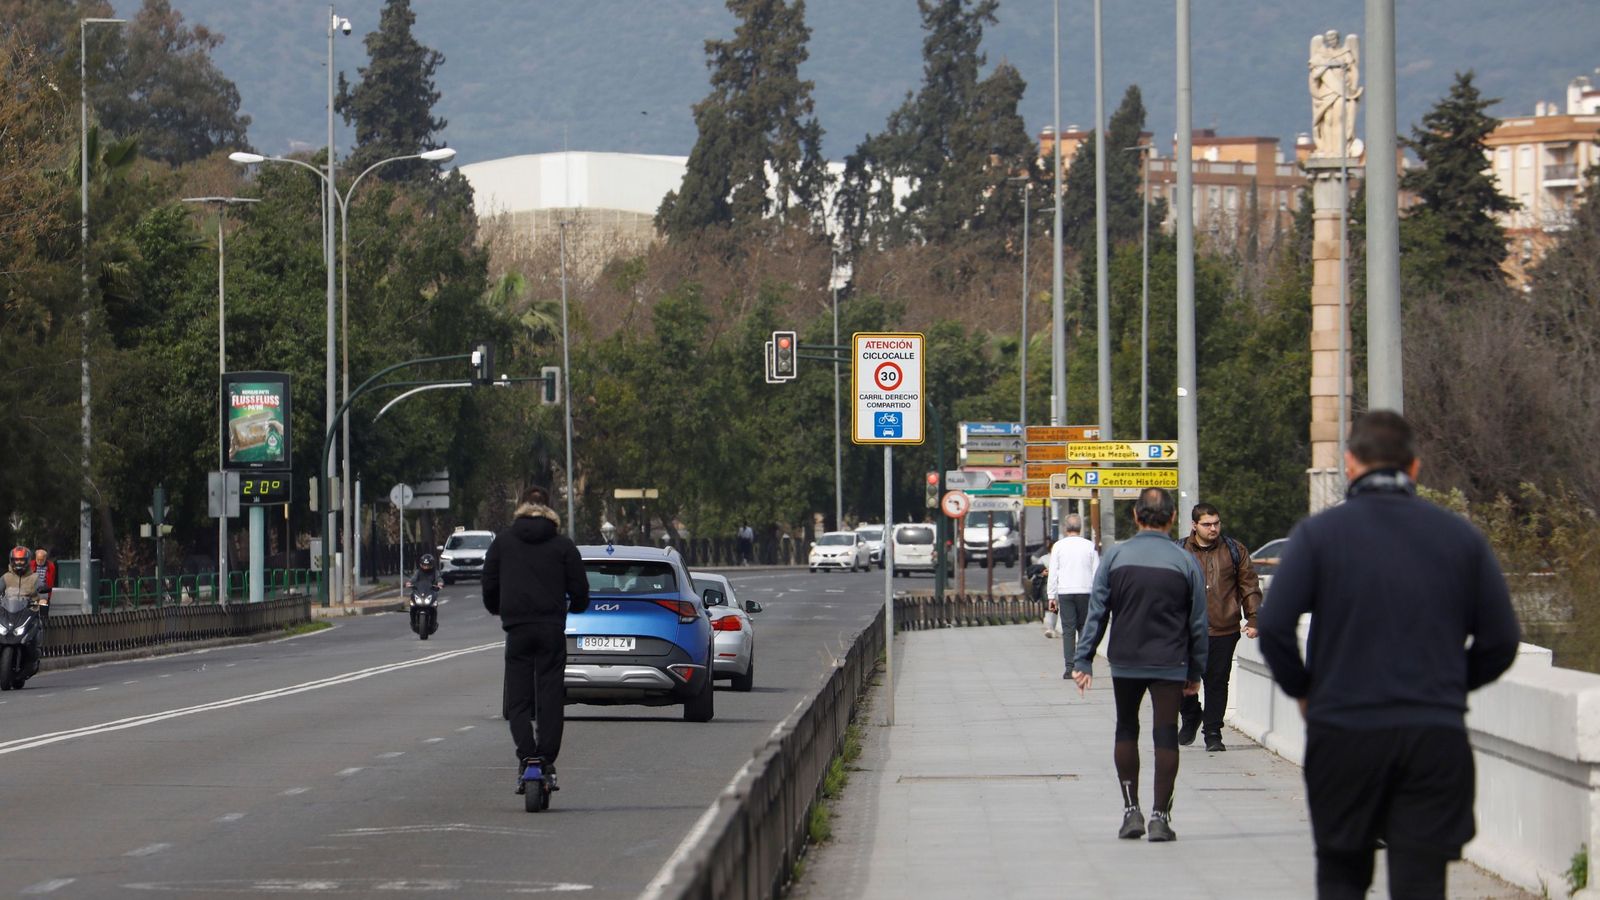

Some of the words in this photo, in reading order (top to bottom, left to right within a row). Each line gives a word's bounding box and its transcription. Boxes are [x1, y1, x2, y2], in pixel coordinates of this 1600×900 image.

[865, 340, 913, 349] ATENCIÓN
[862, 352, 915, 360] CICLOCALLE
[880, 371, 897, 381] 30
[1102, 478, 1133, 486] Centro
[594, 603, 620, 611] KIA
[584, 637, 610, 648] 8902
